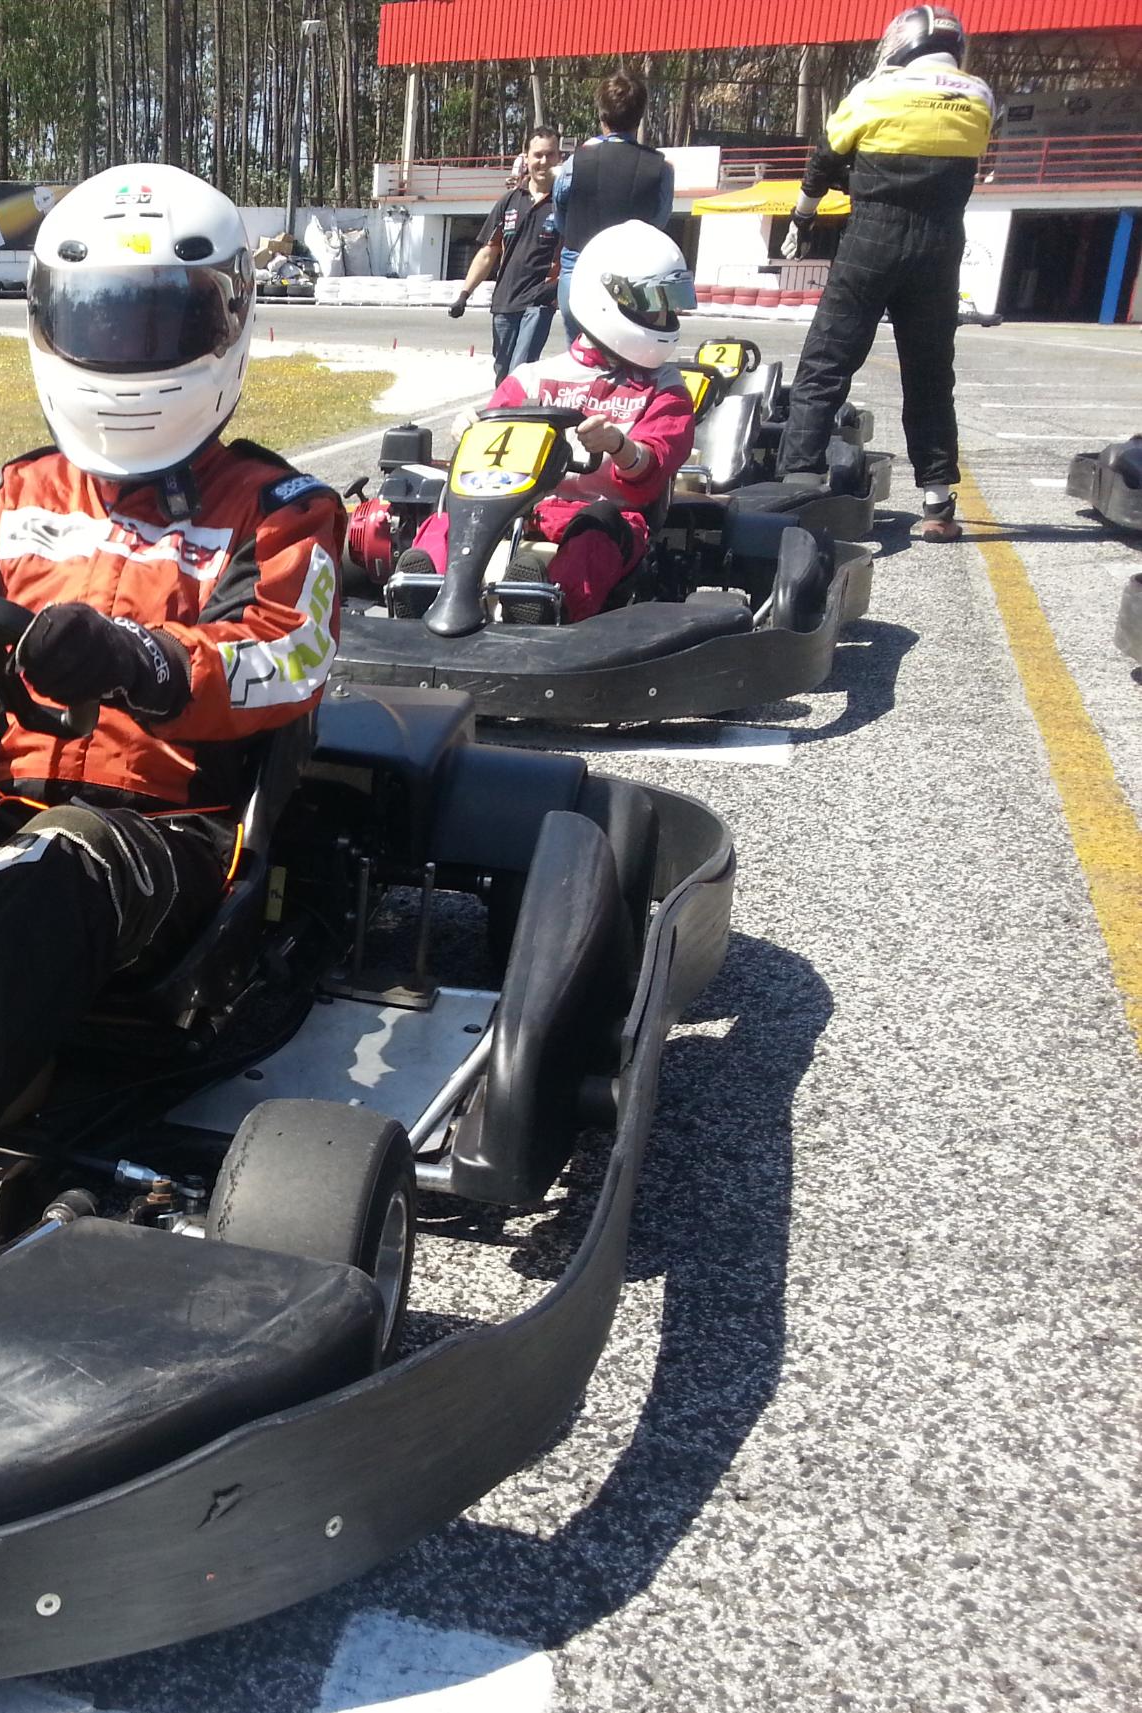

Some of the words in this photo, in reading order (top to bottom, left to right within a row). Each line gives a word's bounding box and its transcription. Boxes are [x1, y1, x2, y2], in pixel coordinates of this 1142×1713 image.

[714, 346, 726, 363] 2
[543, 389, 646, 411] Millennium
[611, 409, 631, 419] bcp
[483, 426, 514, 467] 4
[114, 616, 170, 684] sparco
